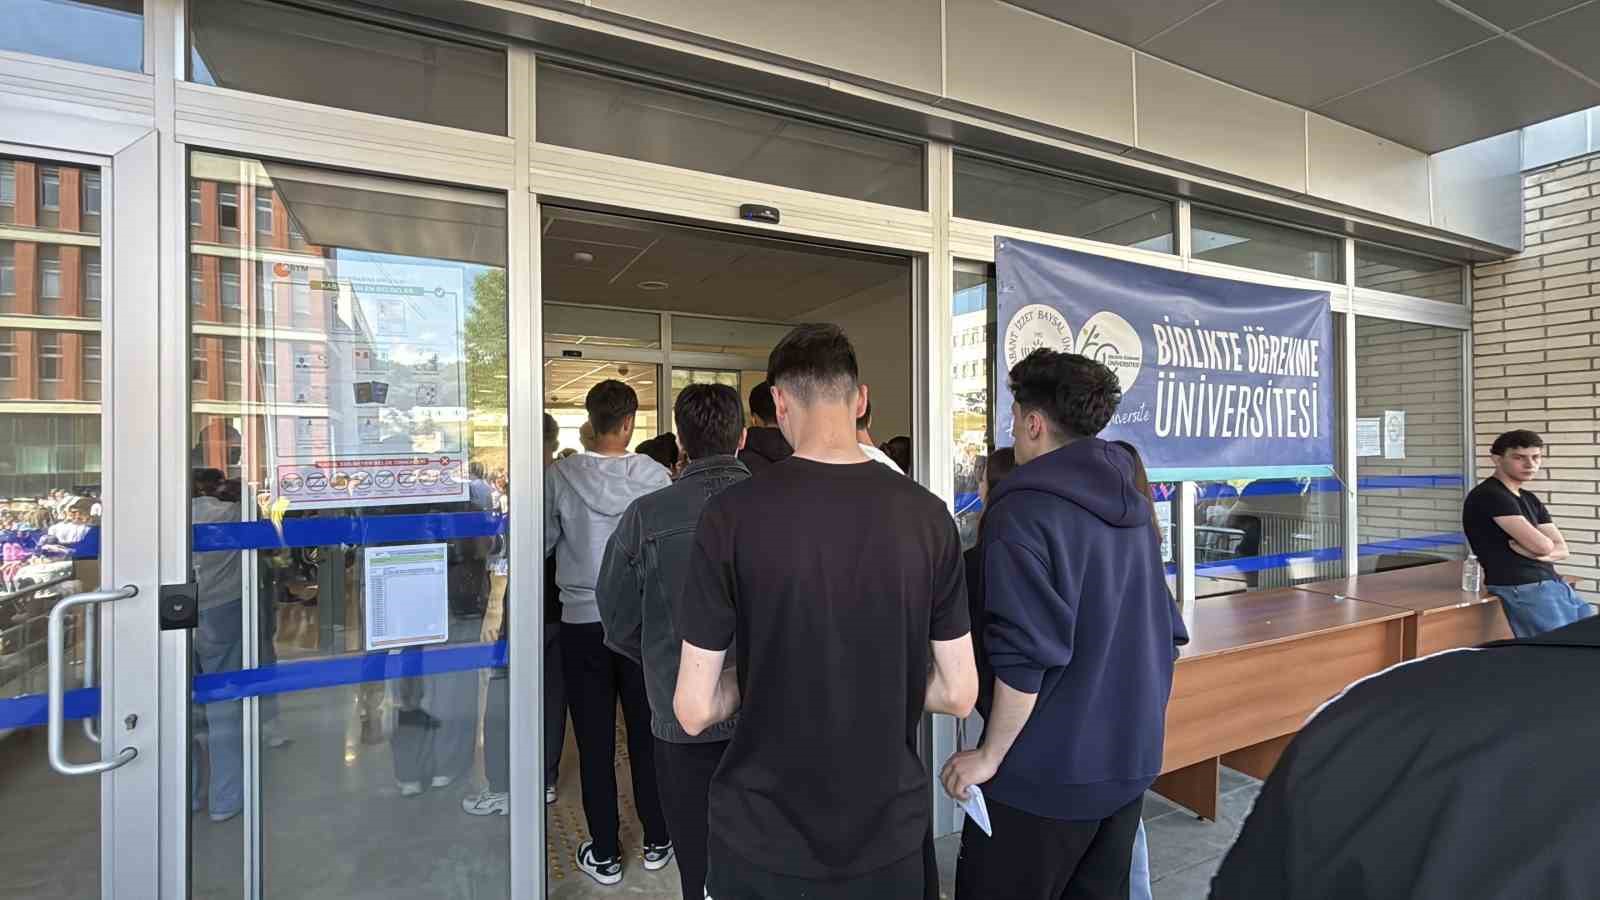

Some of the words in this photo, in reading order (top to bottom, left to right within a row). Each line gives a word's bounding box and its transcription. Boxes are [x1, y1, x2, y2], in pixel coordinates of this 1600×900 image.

[1038, 310, 1065, 335] BAYSAL
[1152, 315, 1243, 371] BİRLİKTE
[1243, 326, 1319, 377] ÖĞRENME
[1154, 371, 1319, 438] ÜNİVERSİTESİ
